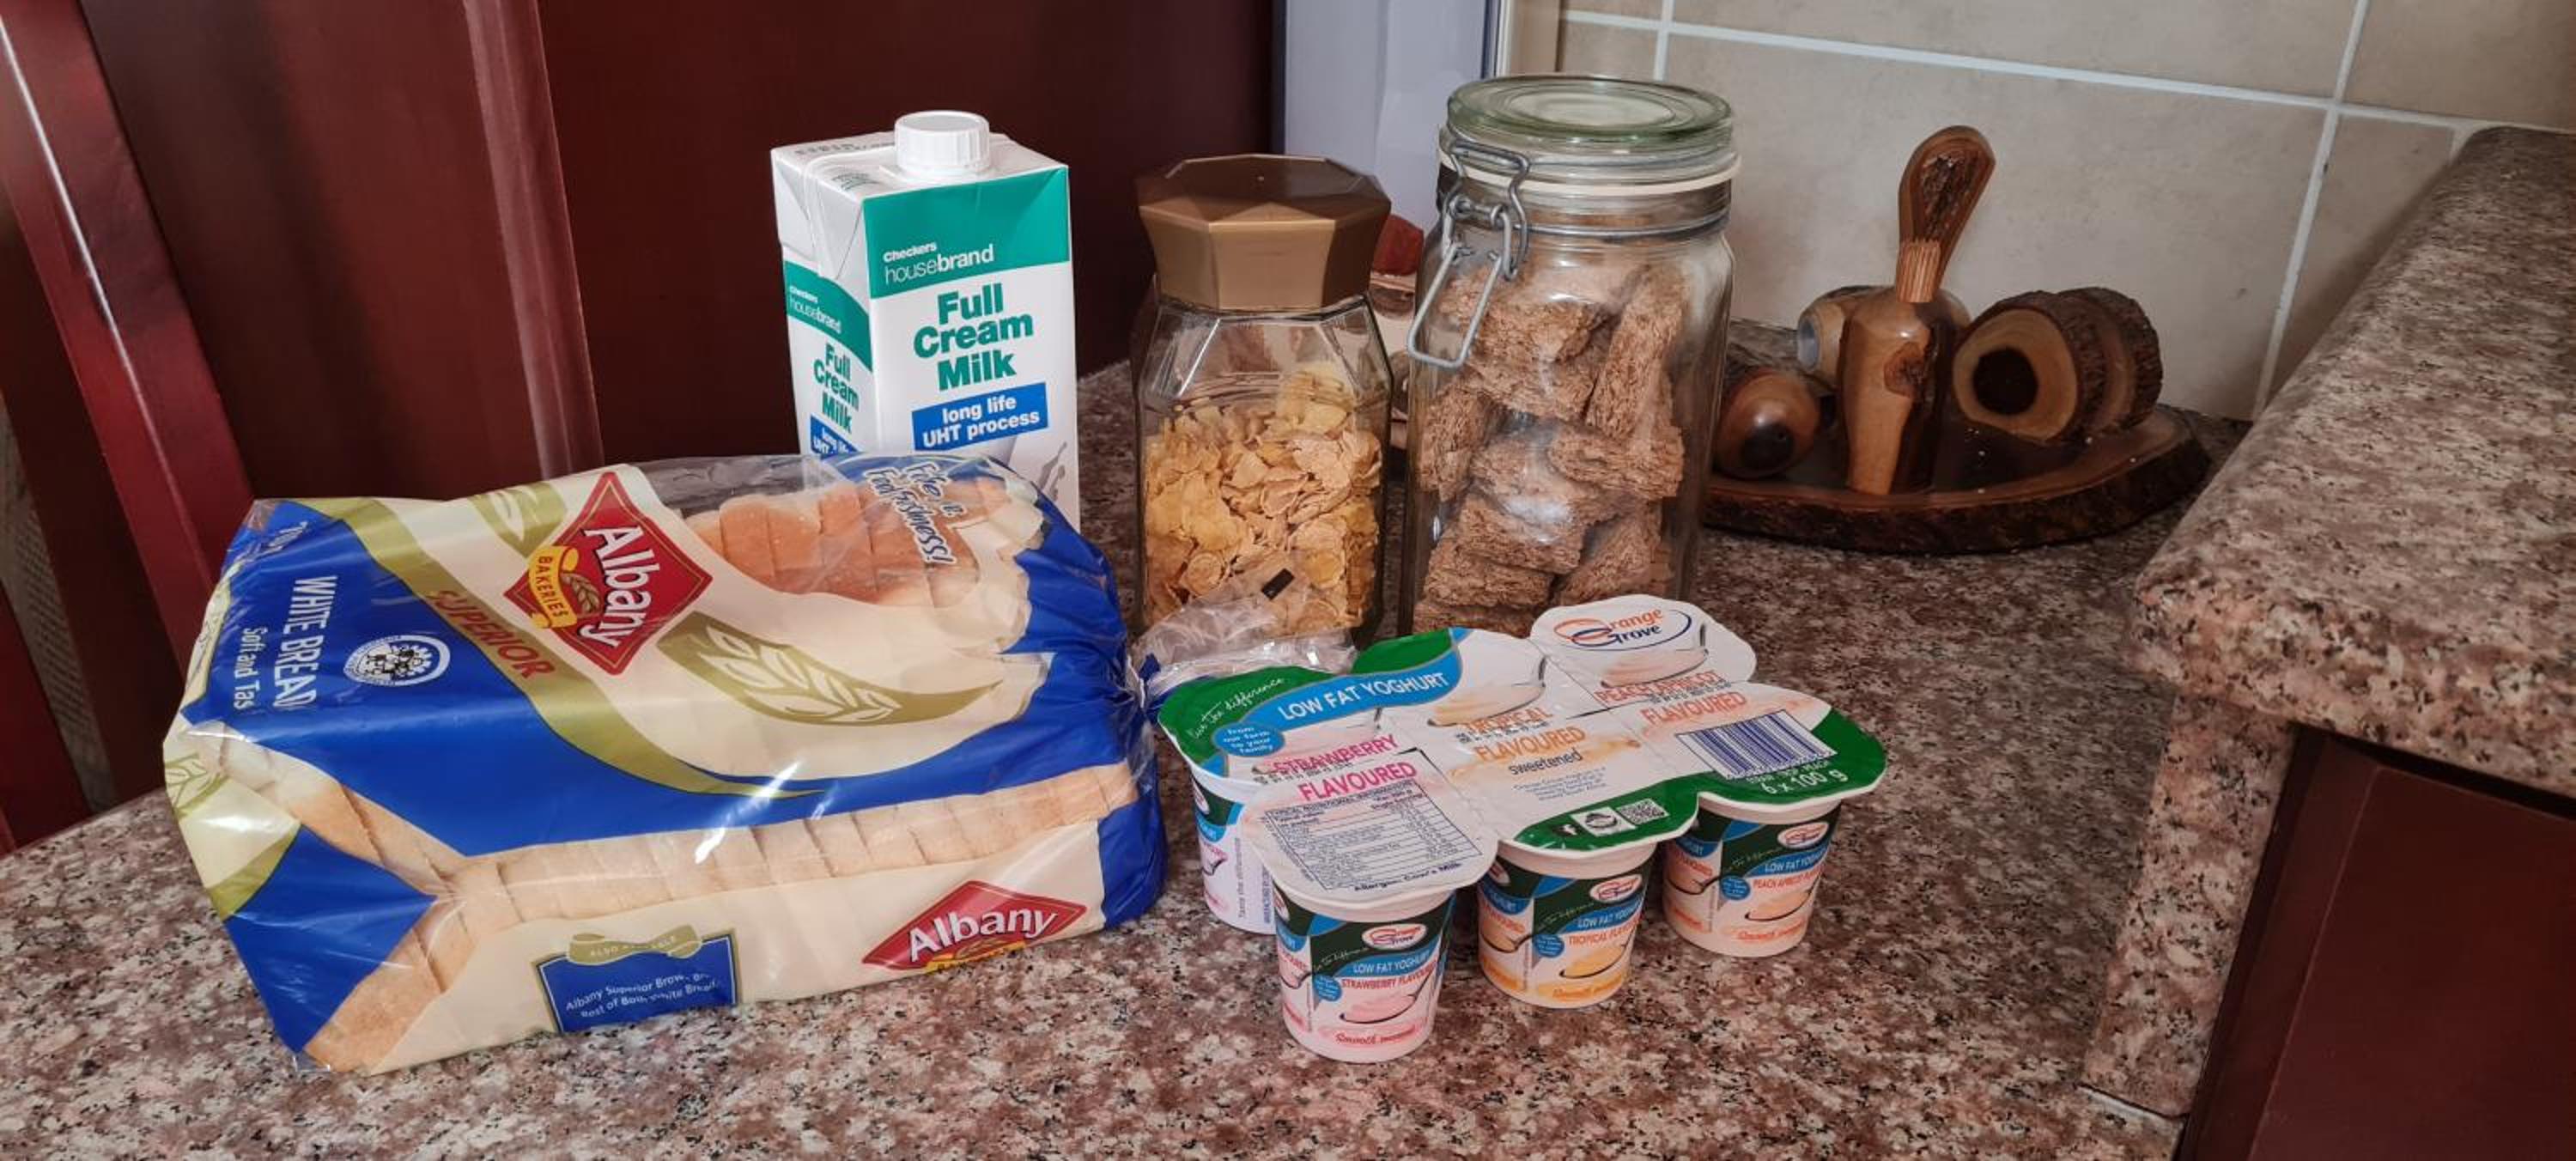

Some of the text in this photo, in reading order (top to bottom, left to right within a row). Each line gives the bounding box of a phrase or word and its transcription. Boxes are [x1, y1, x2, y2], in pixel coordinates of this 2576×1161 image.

[883, 241, 937, 263] Checkers
[885, 244, 994, 284] housebrand
[937, 283, 1004, 325] Full
[914, 313, 1035, 358] Cream
[825, 342, 851, 382] Full
[938, 350, 1018, 391] Milk
[814, 358, 860, 412] Cream
[822, 392, 853, 435] Milk
[943, 393, 1018, 424] long life
[922, 411, 1041, 448] UHT process
[283, 575, 337, 635] WHITE
[535, 554, 570, 620] BAKERIES
[584, 523, 661, 648] Albany
[241, 627, 269, 652] Soft
[429, 589, 556, 680] SUPERIOR
[234, 651, 257, 678] and
[272, 635, 325, 709] BREAD
[1225, 677, 1285, 708] difference
[1278, 672, 1451, 721] LOW FAT YOGHURT
[1639, 690, 1747, 725] FLAVOURED
[1273, 733, 1399, 775] STRAWBERRY
[1473, 726, 1585, 763] FLAVOURED
[1509, 747, 1583, 775] sweetened
[1297, 762, 1417, 801] FLAVOURED
[1761, 769, 1849, 794] 6 x 100 g
[1765, 861, 1784, 872] LOW
[1785, 859, 1801, 871] FAT
[908, 908, 1058, 963] Albany
[1577, 916, 1597, 928] LOW
[1352, 949, 1431, 974] LOW FAT YOGHURT
[565, 990, 603, 1012] Albany
[605, 982, 653, 997] Superior
[1341, 977, 1395, 989] STRAWBERRY
